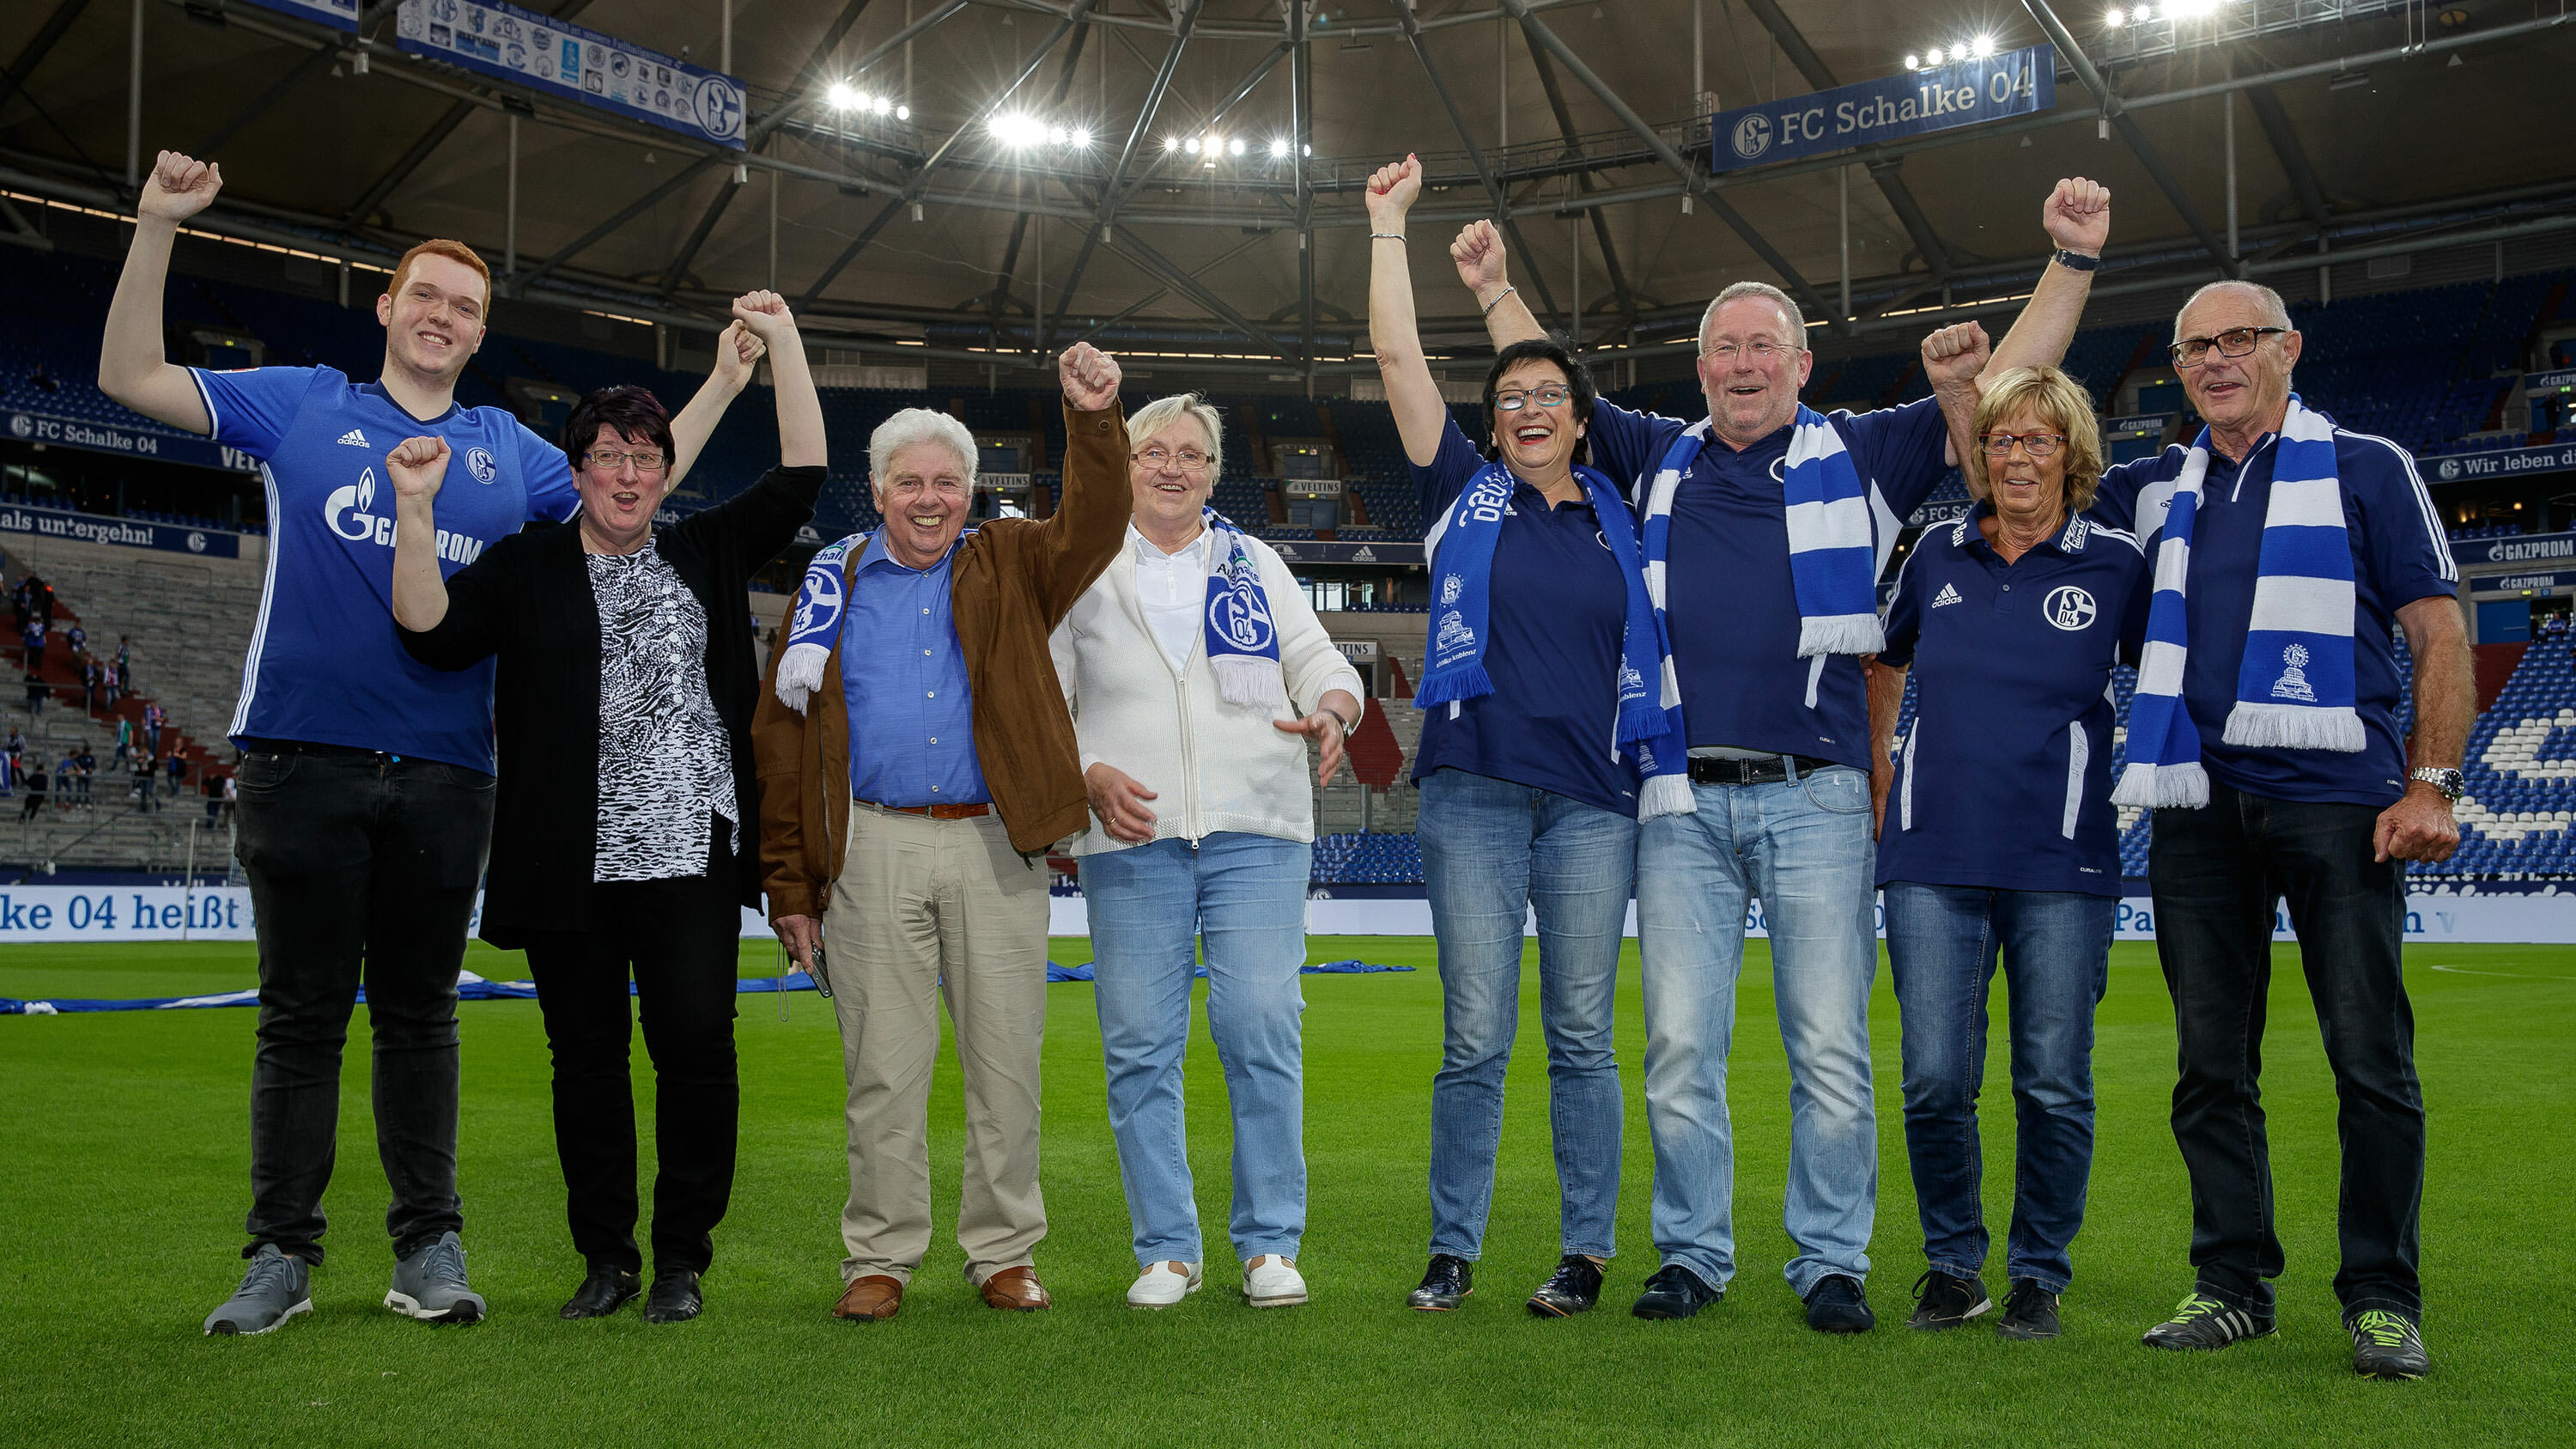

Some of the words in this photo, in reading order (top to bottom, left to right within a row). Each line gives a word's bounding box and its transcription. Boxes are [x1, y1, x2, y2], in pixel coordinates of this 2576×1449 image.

[1780, 107, 1825, 146] FC
[1835, 85, 1977, 135] Schalke
[1988, 64, 2034, 104] 04
[36, 419, 61, 439] FC
[64, 424, 133, 451] Schalke
[137, 435, 159, 454] 04
[336, 436, 371, 449] adidas
[2464, 459, 2499, 475] Wir
[2504, 454, 2555, 472] leben
[988, 475, 1029, 485] VELTINS
[1301, 482, 1340, 492] VELTINS
[1929, 507, 1948, 521] FC
[37, 514, 155, 546] untergehn!
[2505, 539, 2574, 561] GAZPROM
[2510, 575, 2555, 590] GAZPROM
[1931, 595, 1963, 609] adidas
[67, 896, 118, 931] 04
[131, 893, 240, 931] heißt
